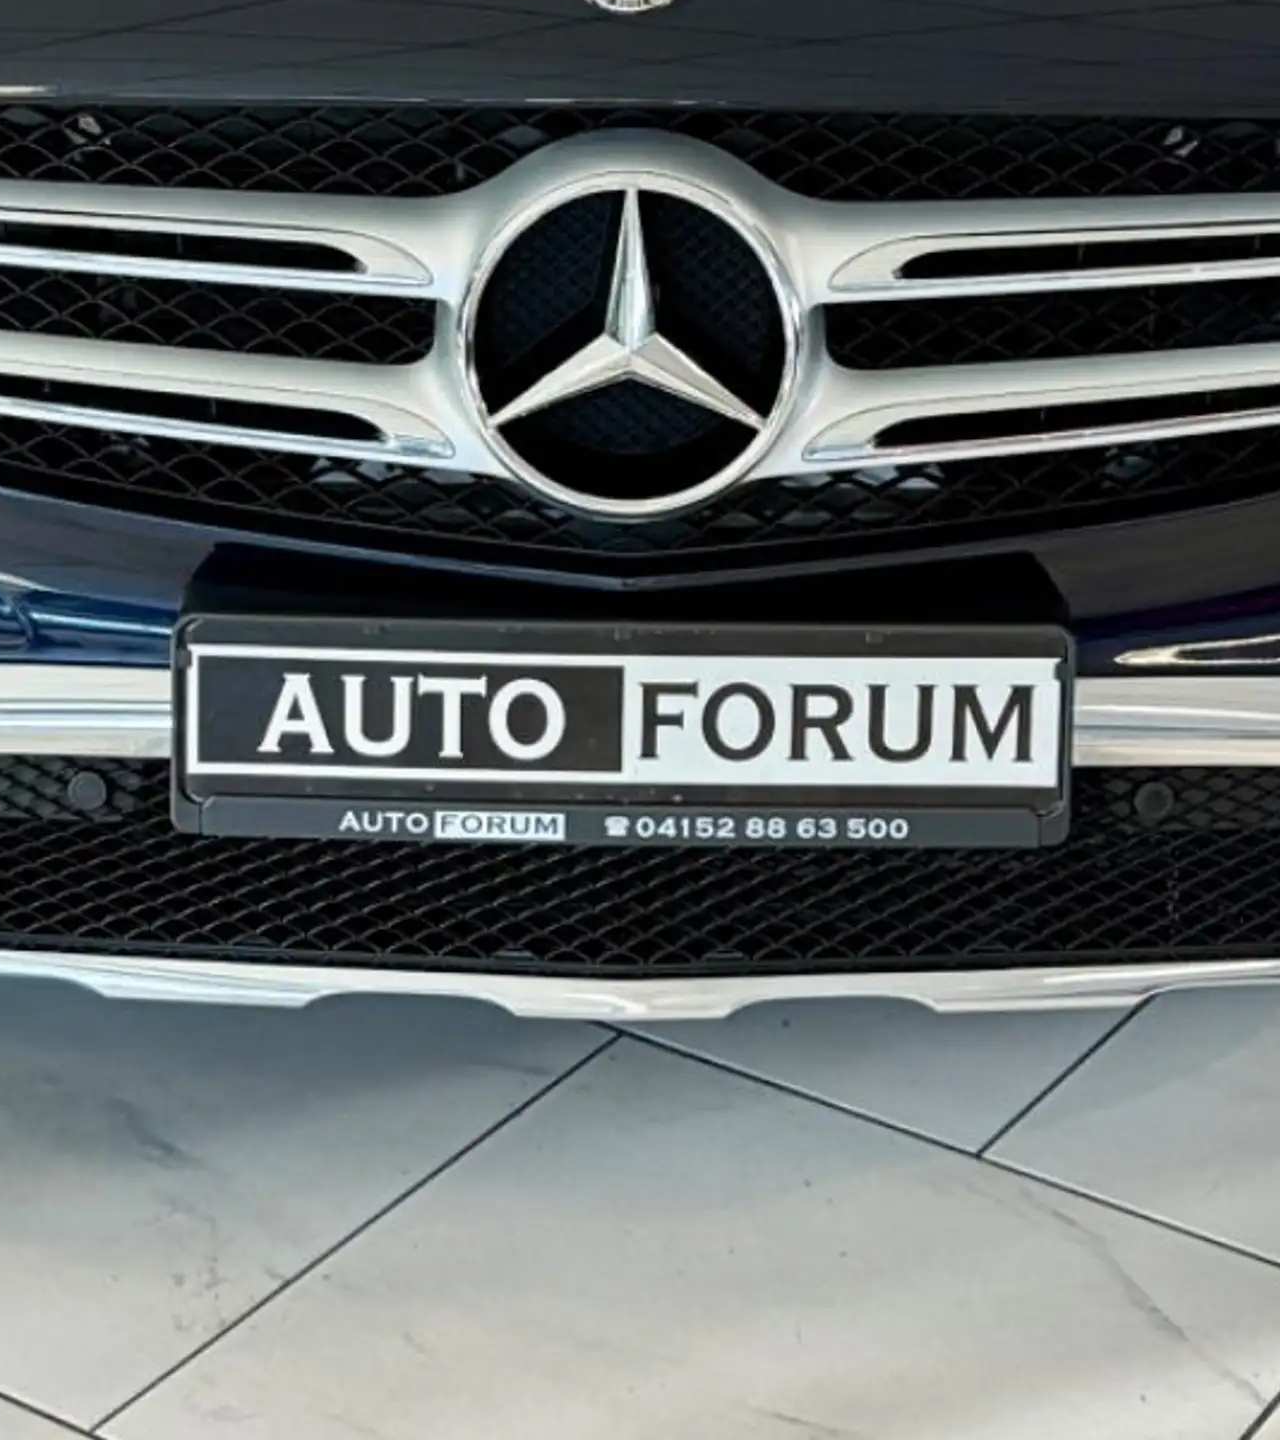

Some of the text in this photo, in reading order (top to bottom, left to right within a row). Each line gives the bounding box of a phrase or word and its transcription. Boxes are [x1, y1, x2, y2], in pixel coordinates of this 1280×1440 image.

[256, 672, 1035, 763] AUTO FORUM
[338, 811, 909, 839] AUTO FORUM 04152 88 63 500
